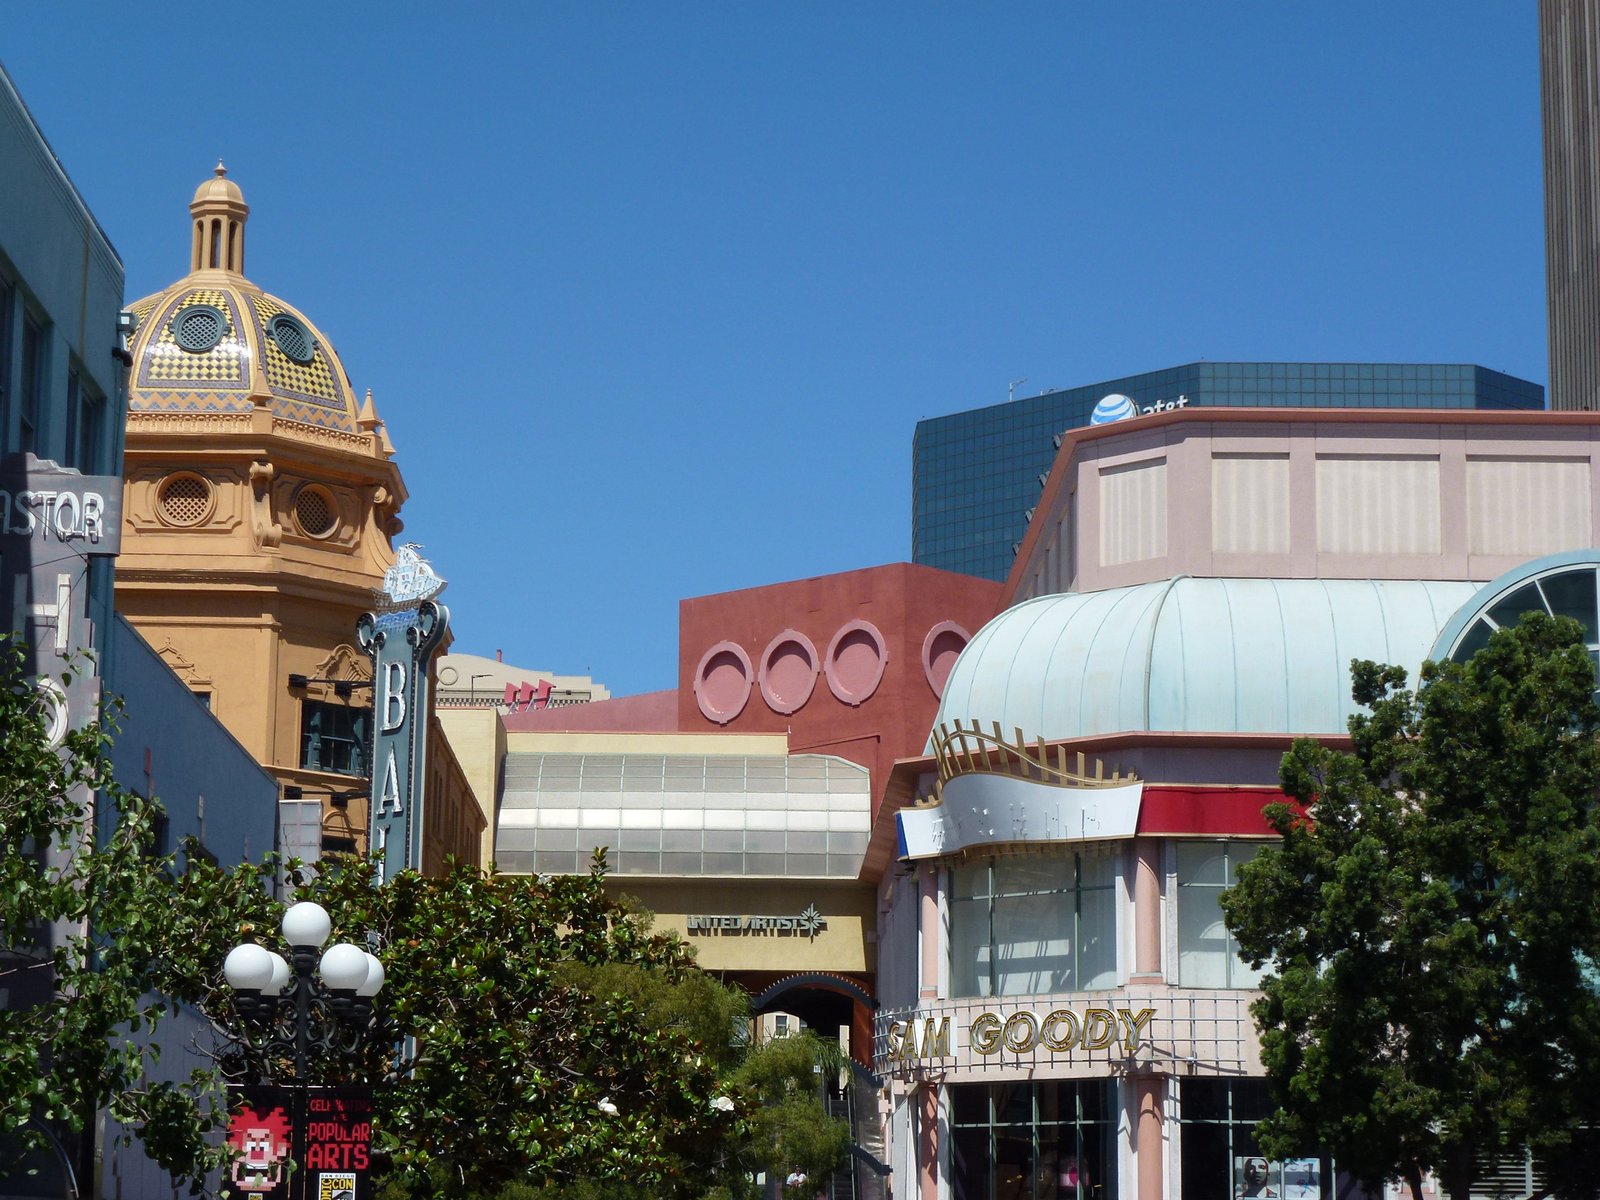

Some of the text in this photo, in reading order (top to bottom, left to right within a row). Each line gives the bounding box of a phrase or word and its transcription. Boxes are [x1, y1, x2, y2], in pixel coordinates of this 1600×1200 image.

[687, 915, 810, 931] UNITED ARTISTS
[887, 1008, 1158, 1062] SAM GOODY
[309, 1122, 370, 1141] POPULAR
[307, 1143, 369, 1169] ARTS
[332, 1178, 353, 1189] CON
